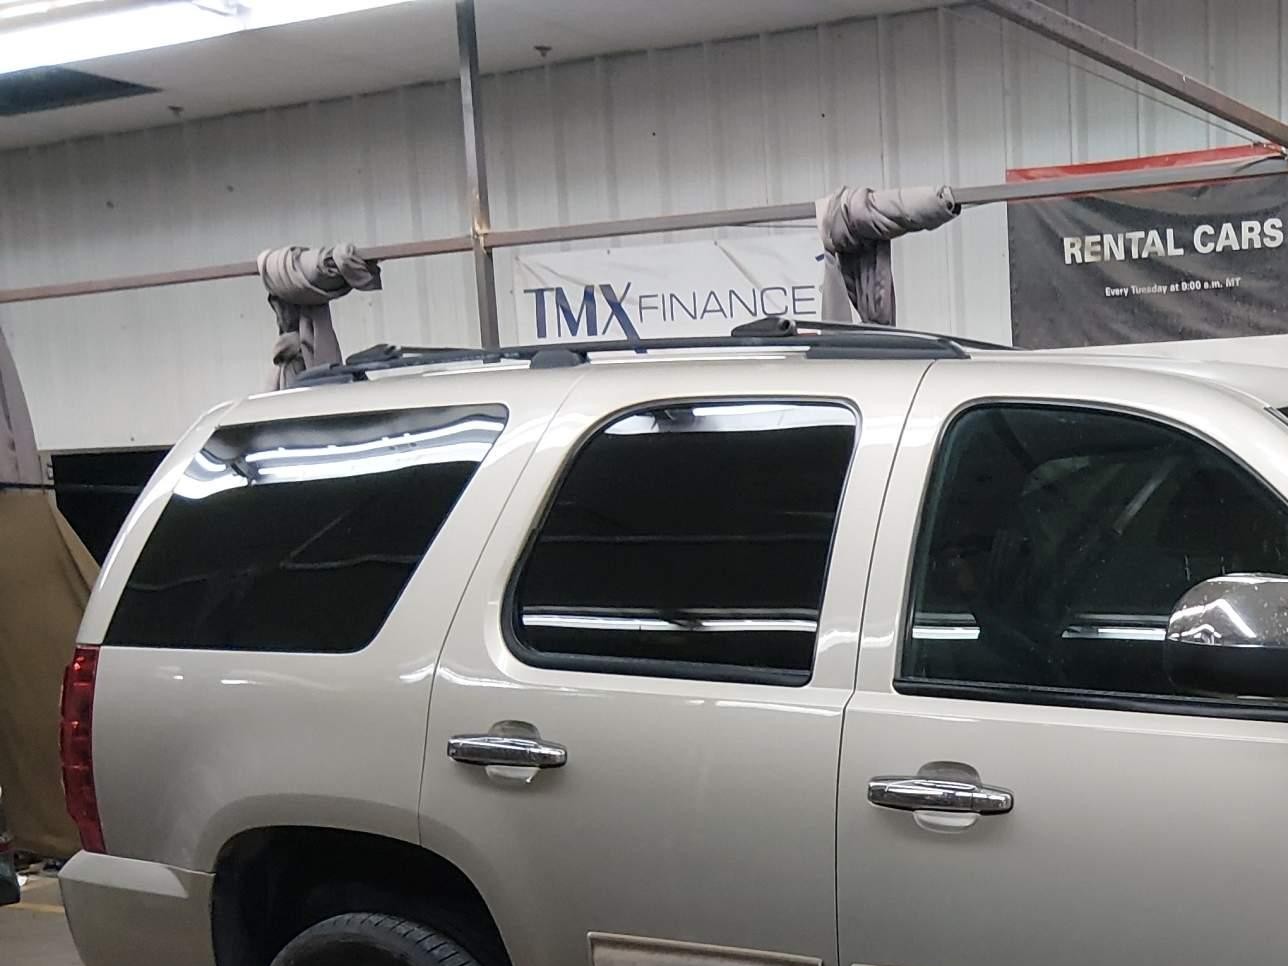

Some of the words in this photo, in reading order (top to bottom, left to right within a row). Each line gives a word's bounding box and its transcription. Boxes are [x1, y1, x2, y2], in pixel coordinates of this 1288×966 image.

[1063, 227, 1185, 266] RENTAL
[1193, 217, 1284, 255] CARS
[1105, 285, 1129, 298] Every
[1131, 282, 1168, 296] Tuesday
[1170, 282, 1180, 293] at
[1225, 276, 1242, 289] MT
[523, 281, 648, 354] TMX
[638, 284, 817, 323] FINANCE
